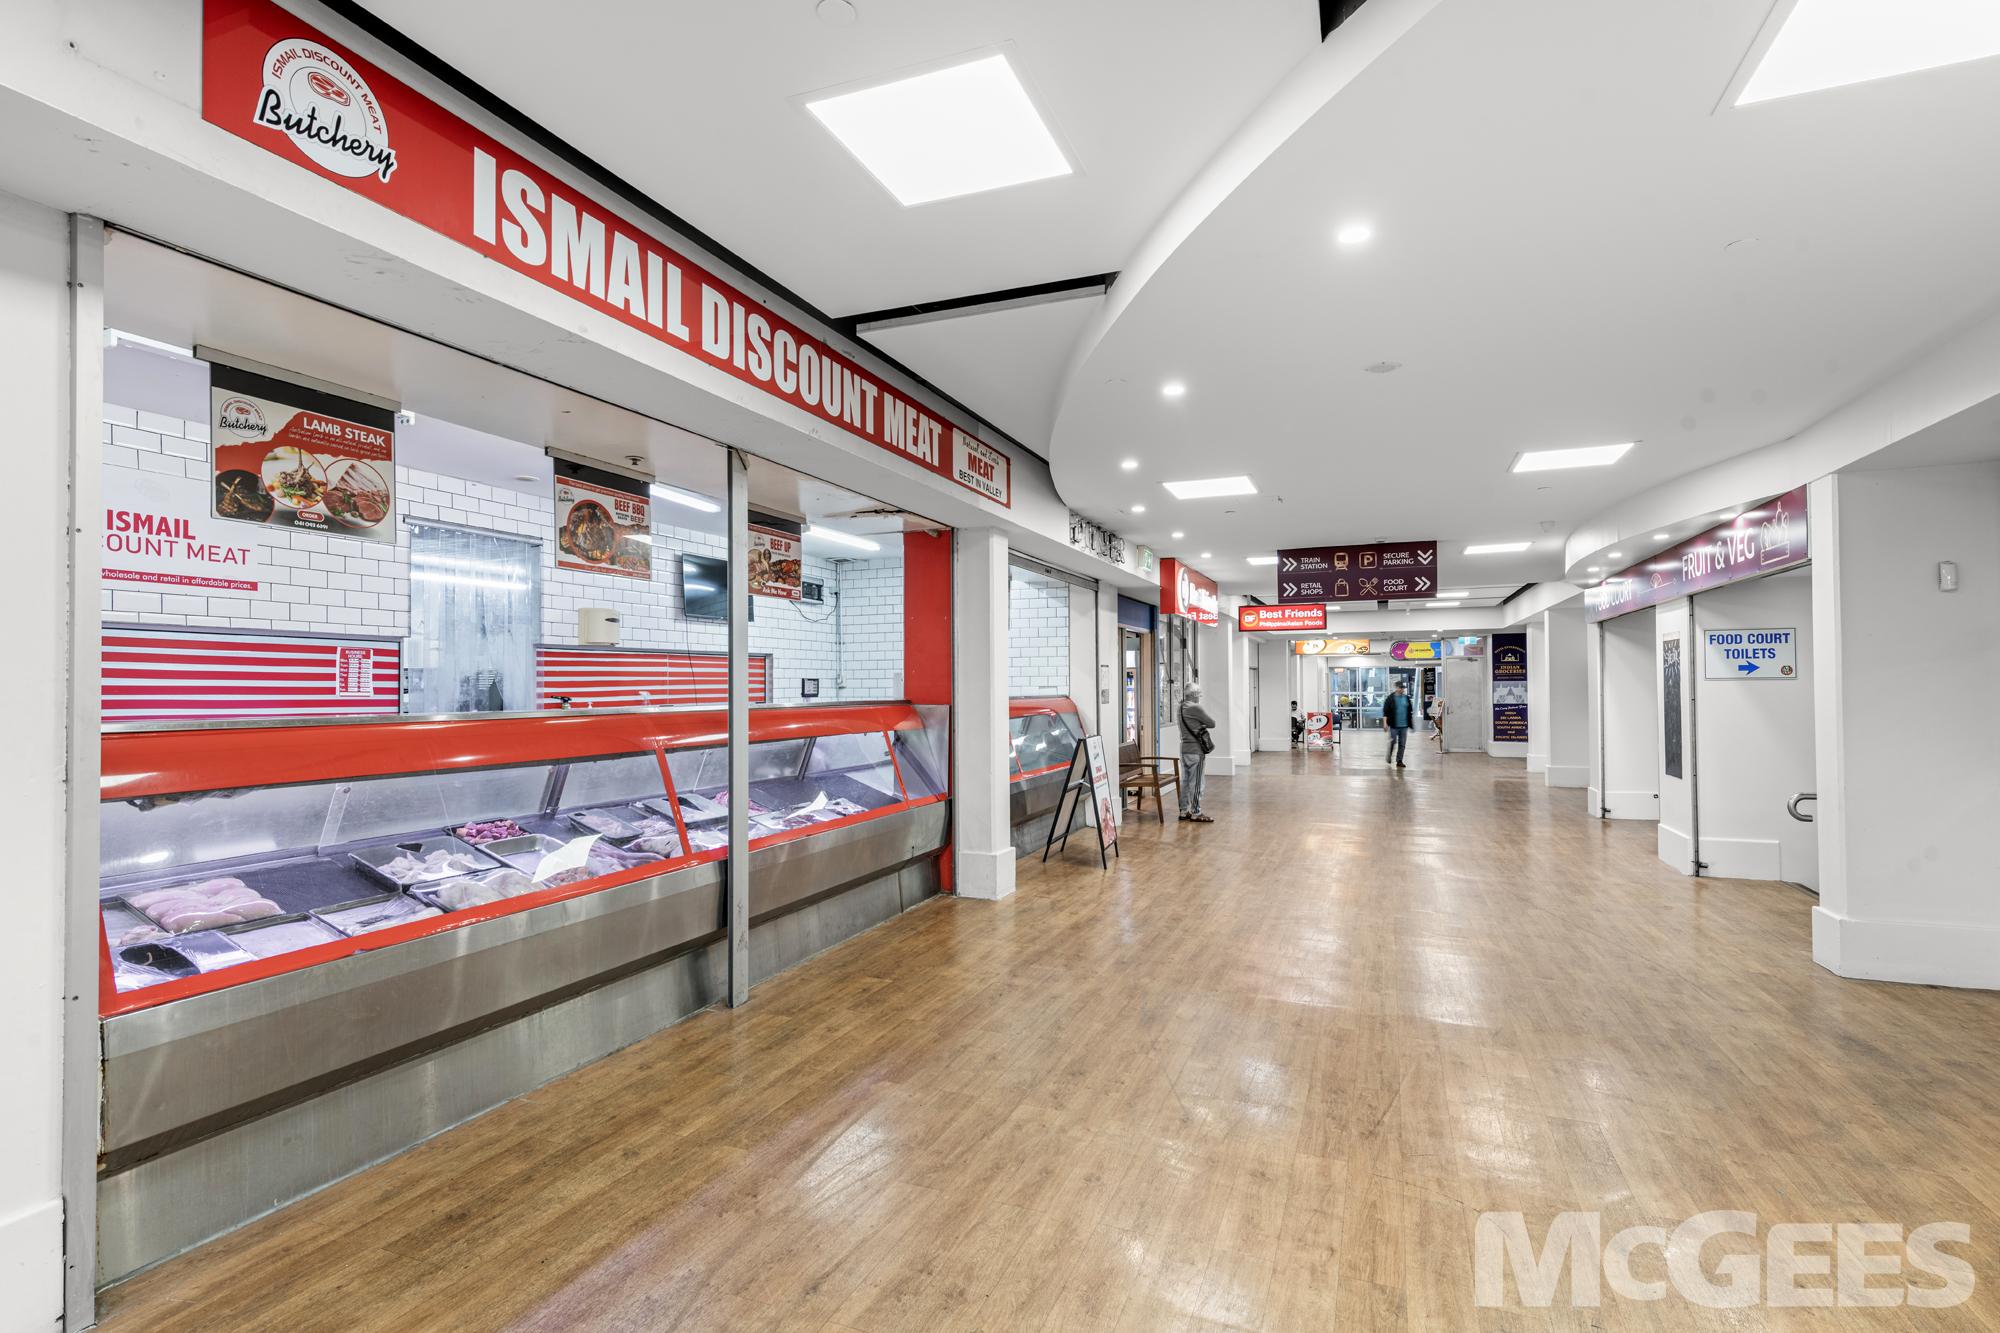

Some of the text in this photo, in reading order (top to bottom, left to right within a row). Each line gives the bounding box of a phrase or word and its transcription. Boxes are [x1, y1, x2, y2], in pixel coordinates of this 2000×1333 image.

[271, 48, 384, 135] ISMAIL DISCOUNT MEAT
[258, 88, 395, 180] Butchery
[473, 146, 942, 467] ISMAIL DISCOUNT MEAT
[219, 416, 267, 436] Butchery
[303, 416, 342, 437] LAMB
[344, 427, 386, 448] STEAK
[968, 452, 995, 482] MEAT
[958, 469, 1003, 499] BEST IN VALLEY
[614, 498, 631, 513] BEEF
[632, 502, 646, 517] BBQ
[106, 508, 197, 542] ISMAIL
[630, 514, 646, 525] BEEF
[101, 533, 251, 566] OUNT MEAT
[769, 537, 784, 551] BEEF
[784, 541, 792, 553] UP
[1300, 556, 1321, 564] TRAIN
[1383, 551, 1410, 560] SECURE
[1383, 557, 1415, 566] PARKING
[1682, 527, 1756, 583] FRUIT & VEG
[1300, 562, 1329, 570] STATION
[142, 574, 159, 582] and
[160, 575, 181, 584] retail
[182, 576, 189, 584] in
[191, 577, 229, 588] affordable
[230, 581, 253, 590] prices.
[1383, 578, 1405, 586] FOOD
[1383, 584, 1408, 593] COURT
[1300, 587, 1324, 596] SHOPS
[1244, 615, 1256, 623] BF
[1259, 608, 1323, 619] Best Friends
[1304, 619, 1323, 627] Foods
[1709, 631, 1791, 646] FOOD COURT
[1724, 647, 1777, 660] TOILETS
